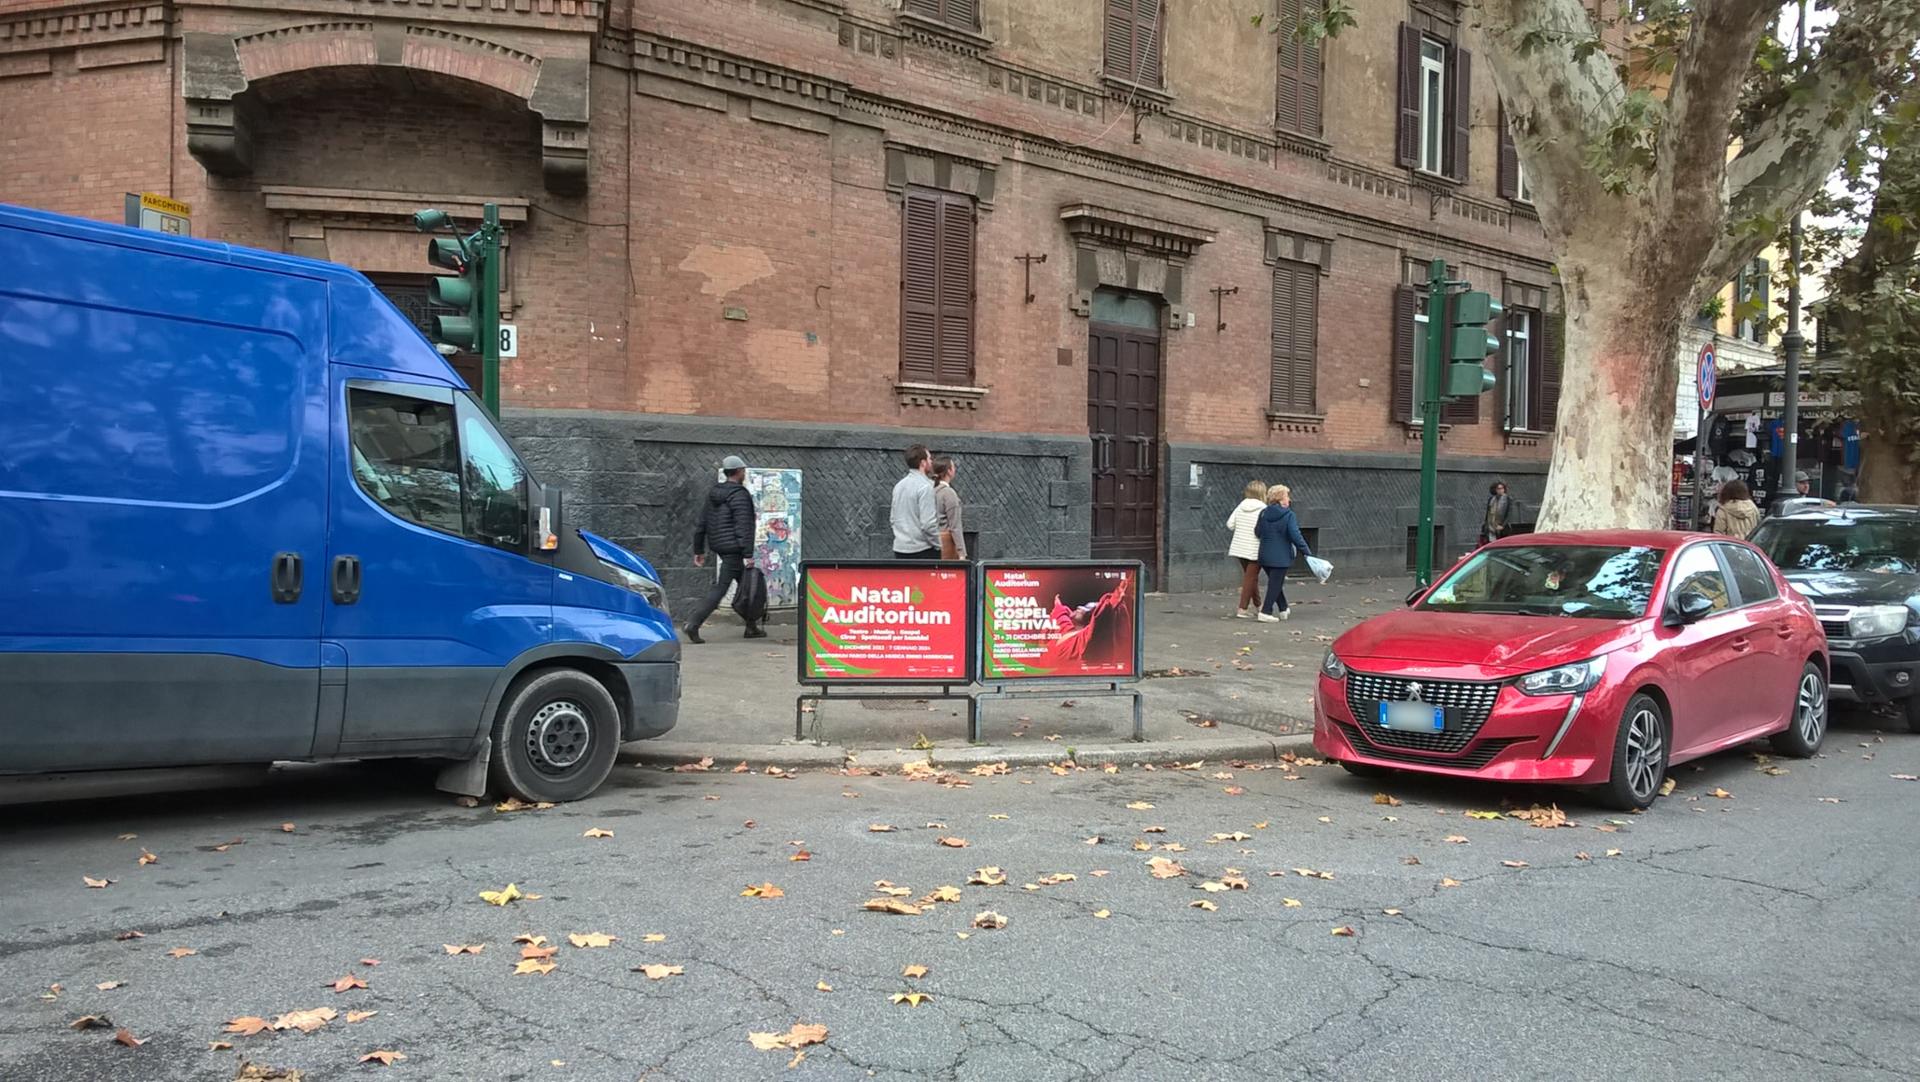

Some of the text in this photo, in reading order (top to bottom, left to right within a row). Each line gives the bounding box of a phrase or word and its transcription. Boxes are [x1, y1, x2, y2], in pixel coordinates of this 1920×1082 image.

[143, 195, 190, 214] PARCOMETRO
[994, 580, 1040, 588] Auditorium
[994, 596, 1039, 608] ROMA
[822, 605, 951, 625] Auditorium
[993, 607, 1051, 619] GOSPEL
[993, 618, 1061, 631] FESTIVAL
